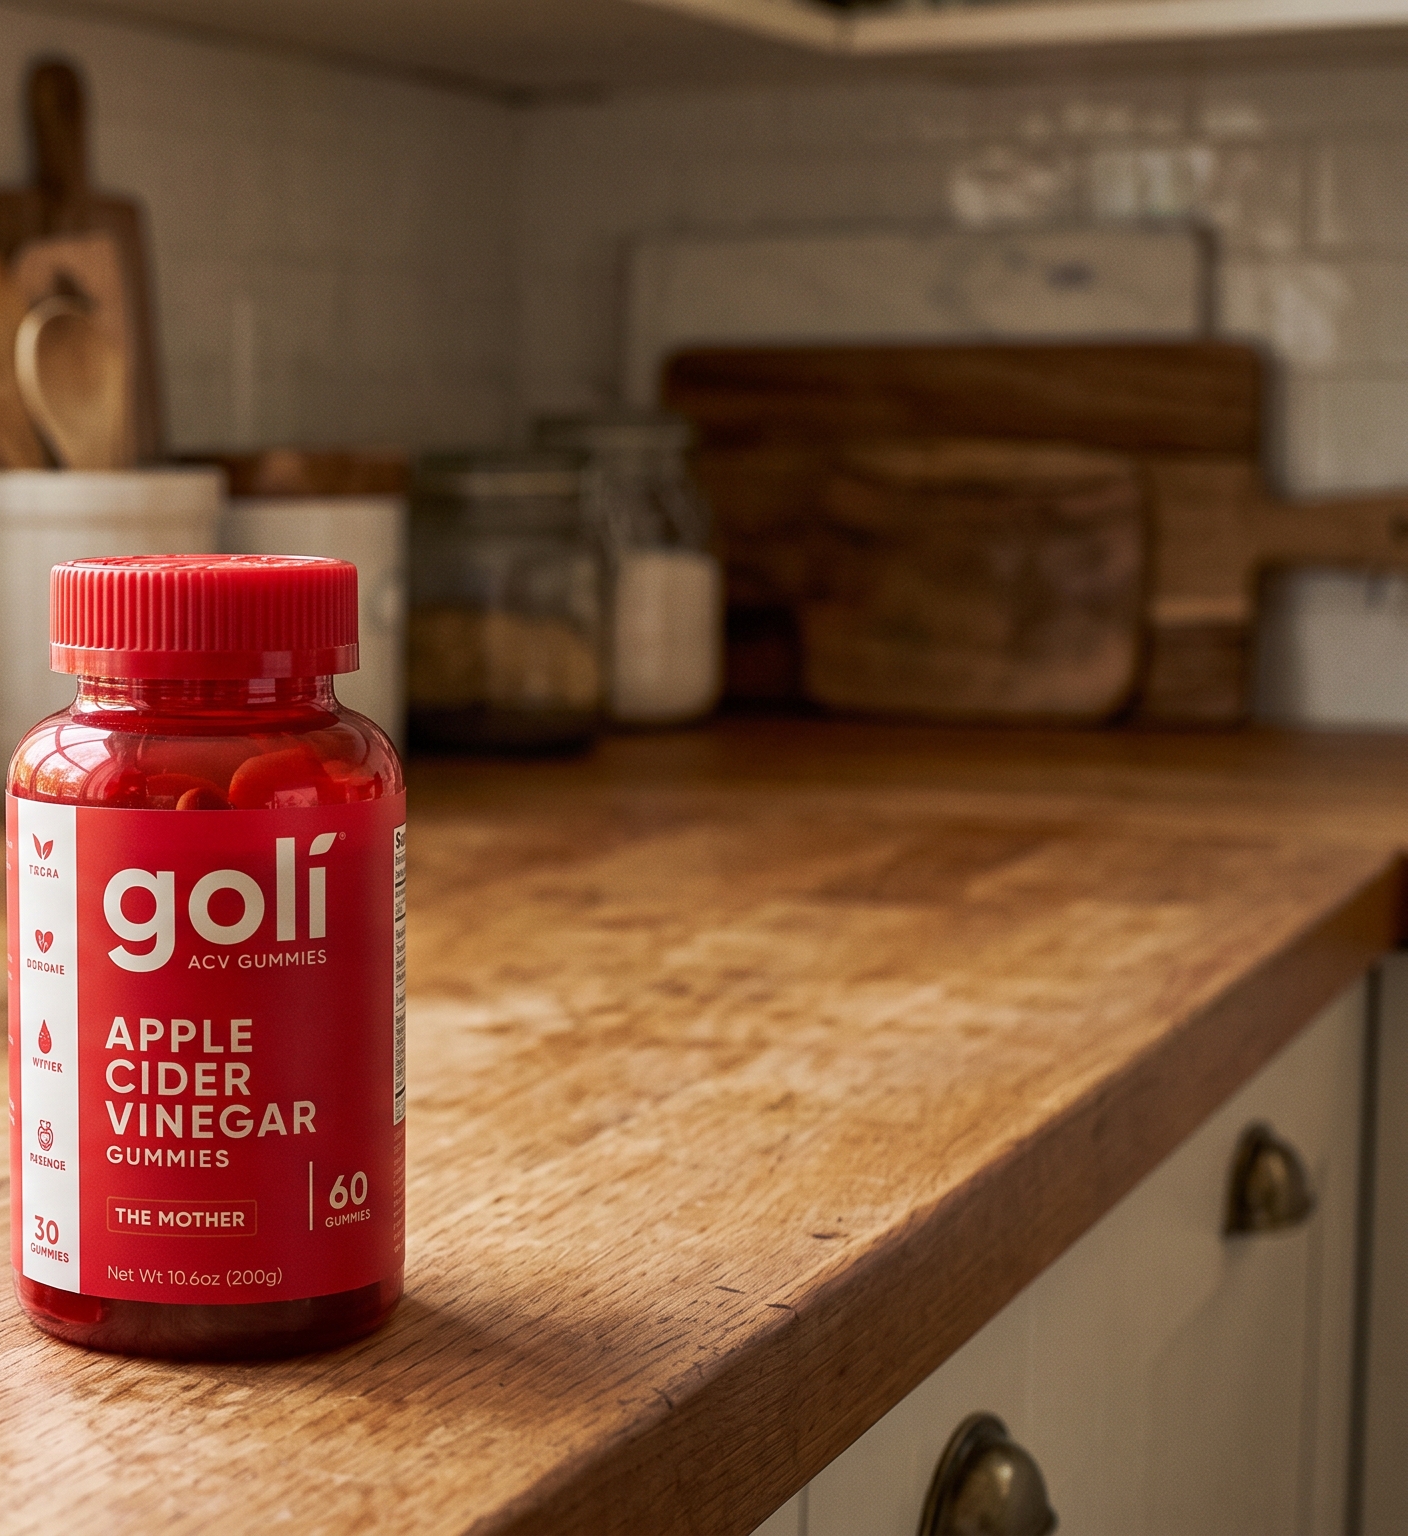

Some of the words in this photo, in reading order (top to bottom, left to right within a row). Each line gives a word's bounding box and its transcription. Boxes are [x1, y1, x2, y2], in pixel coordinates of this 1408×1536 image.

[188, 954, 230, 970] ACV
[239, 949, 327, 969] GUMMIES
[105, 1016, 253, 1053] APPLE
[105, 1058, 251, 1096] CIDER
[105, 1100, 317, 1139] VINEGAR
[106, 1145, 230, 1168] GUMMIES
[329, 1170, 368, 1210] 60
[114, 1207, 152, 1226] THE
[158, 1210, 245, 1228] MOTHER
[325, 1208, 371, 1228] GUMMIES
[34, 1214, 59, 1246] 30
[30, 1242, 70, 1264] GUMMIES
[107, 1265, 135, 1282] Net
[138, 1267, 164, 1285] Wt
[167, 1269, 221, 1286] 10.6oz
[225, 1266, 284, 1288] (200g)
